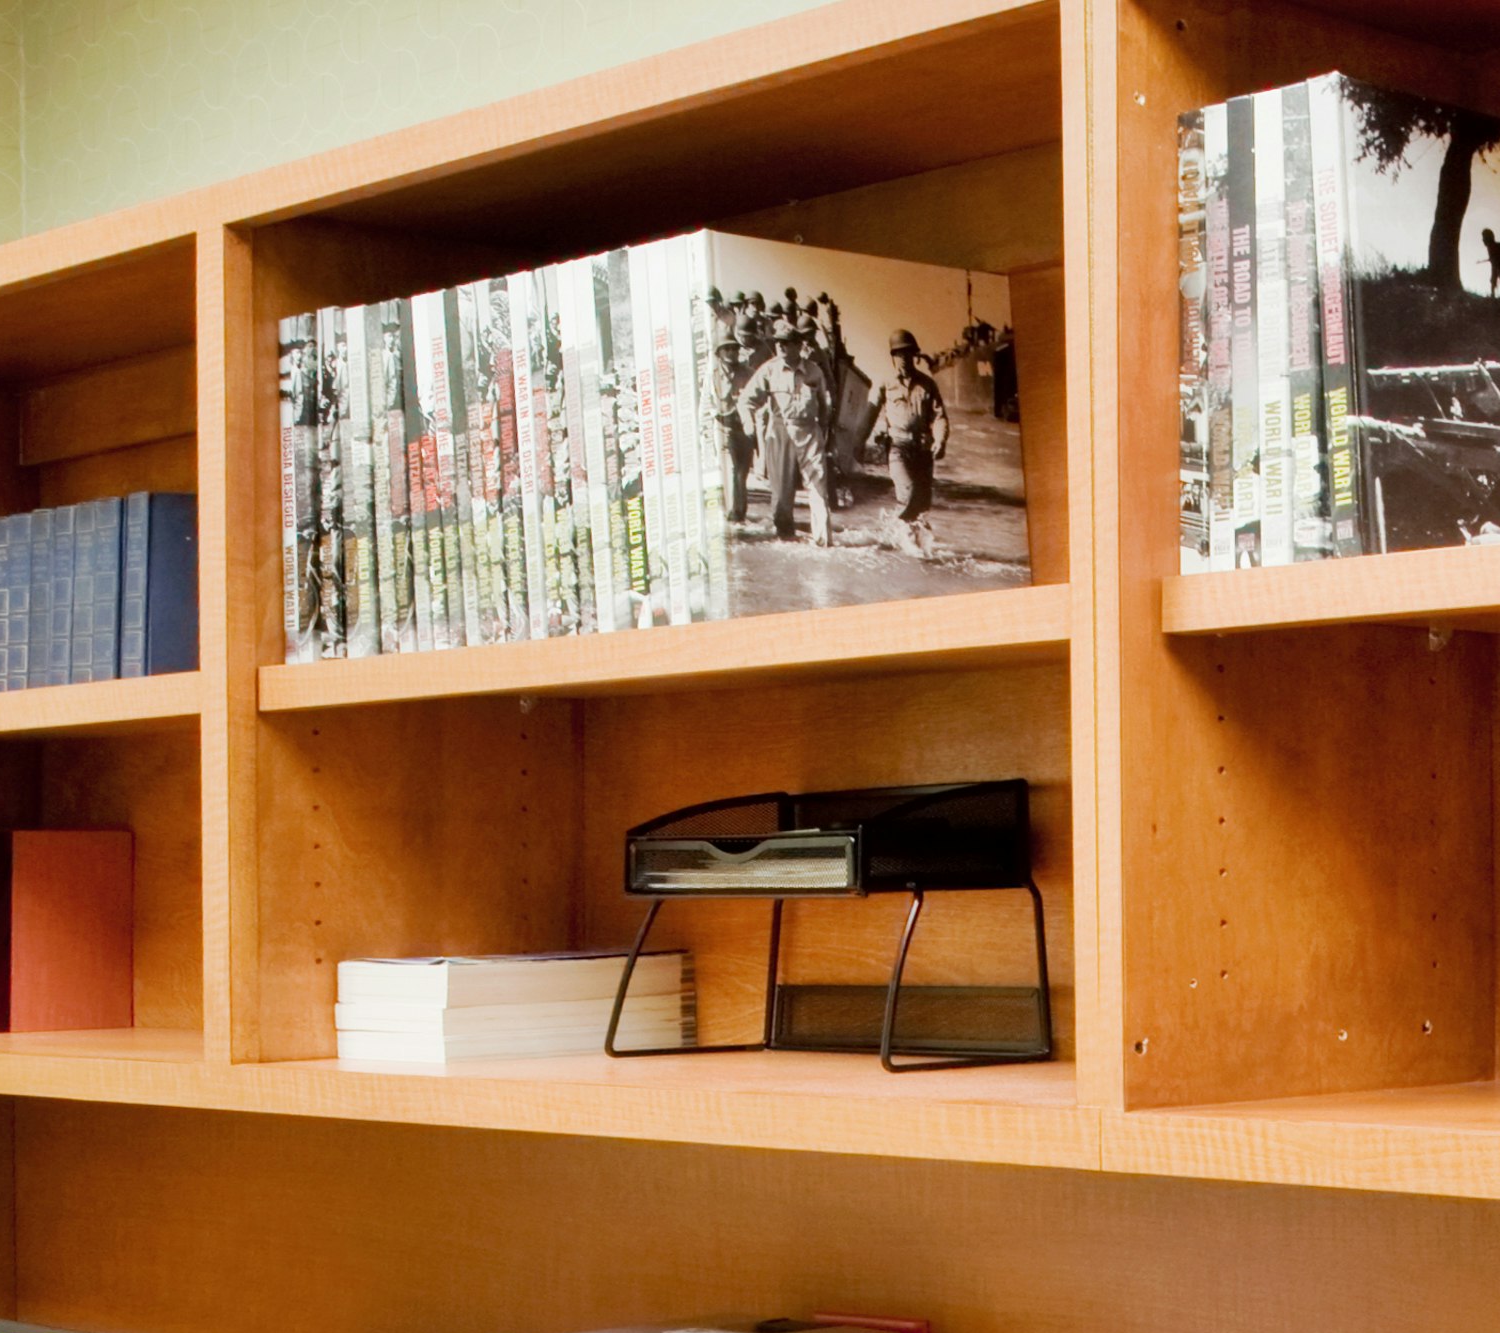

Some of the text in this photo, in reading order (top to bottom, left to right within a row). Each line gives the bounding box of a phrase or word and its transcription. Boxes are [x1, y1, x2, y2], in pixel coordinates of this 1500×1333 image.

[1318, 168, 1335, 198] THE
[1319, 202, 1338, 253] SOVIET
[1232, 225, 1251, 325] THE ROAD TO
[431, 336, 443, 358] THE
[433, 361, 446, 403] BATTLE
[514, 348, 535, 494] THE WAR IN THE DESERT
[638, 369, 656, 477] ISLAND FIGHTING
[655, 328, 674, 475] THE BATTLE OF BRITAIN
[1263, 400, 1281, 457] WORLD
[281, 427, 294, 528] RUSSIA BESIEGED
[1264, 463, 1282, 498] WAR
[1329, 388, 1352, 504] WORLD WAR II
[626, 498, 645, 590] WORLD WAR II
[1266, 504, 1282, 515] II
[284, 545, 296, 628] WORLD WAR II
